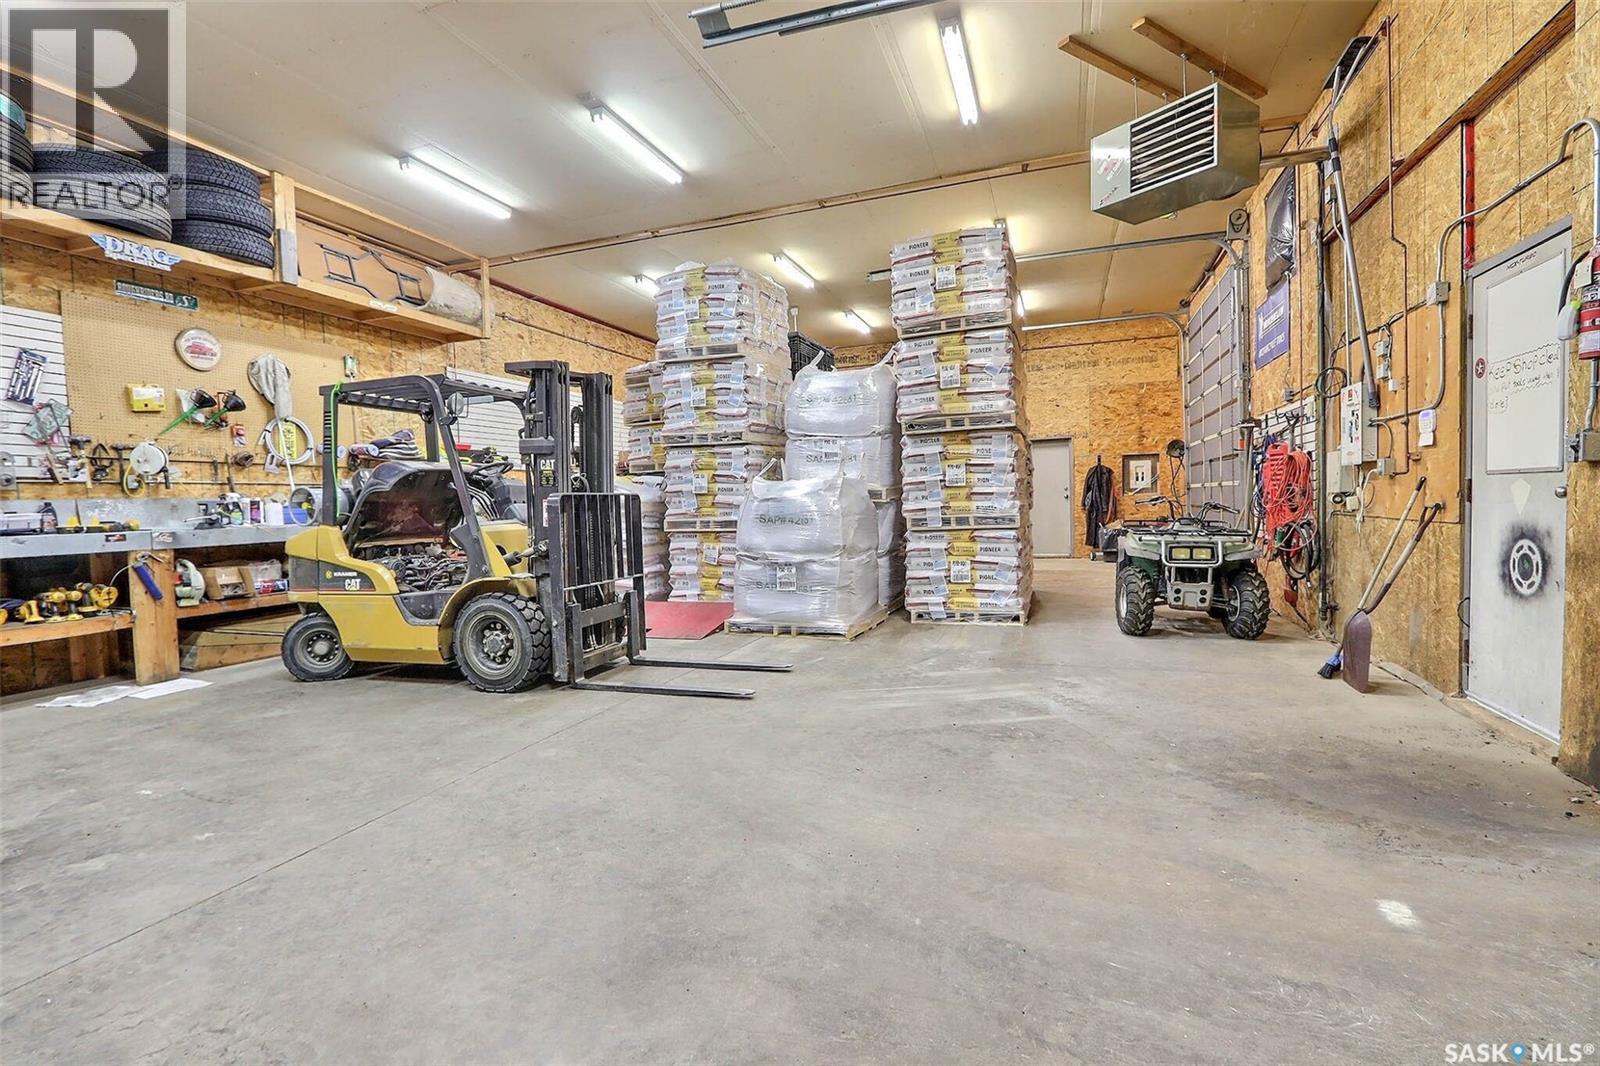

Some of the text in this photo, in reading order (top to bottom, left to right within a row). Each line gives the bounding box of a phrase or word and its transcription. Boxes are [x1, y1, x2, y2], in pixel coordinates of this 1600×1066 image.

[909, 241, 929, 250] PIONEER
[540, 459, 555, 470] CAT
[344, 578, 361, 591] CAT
